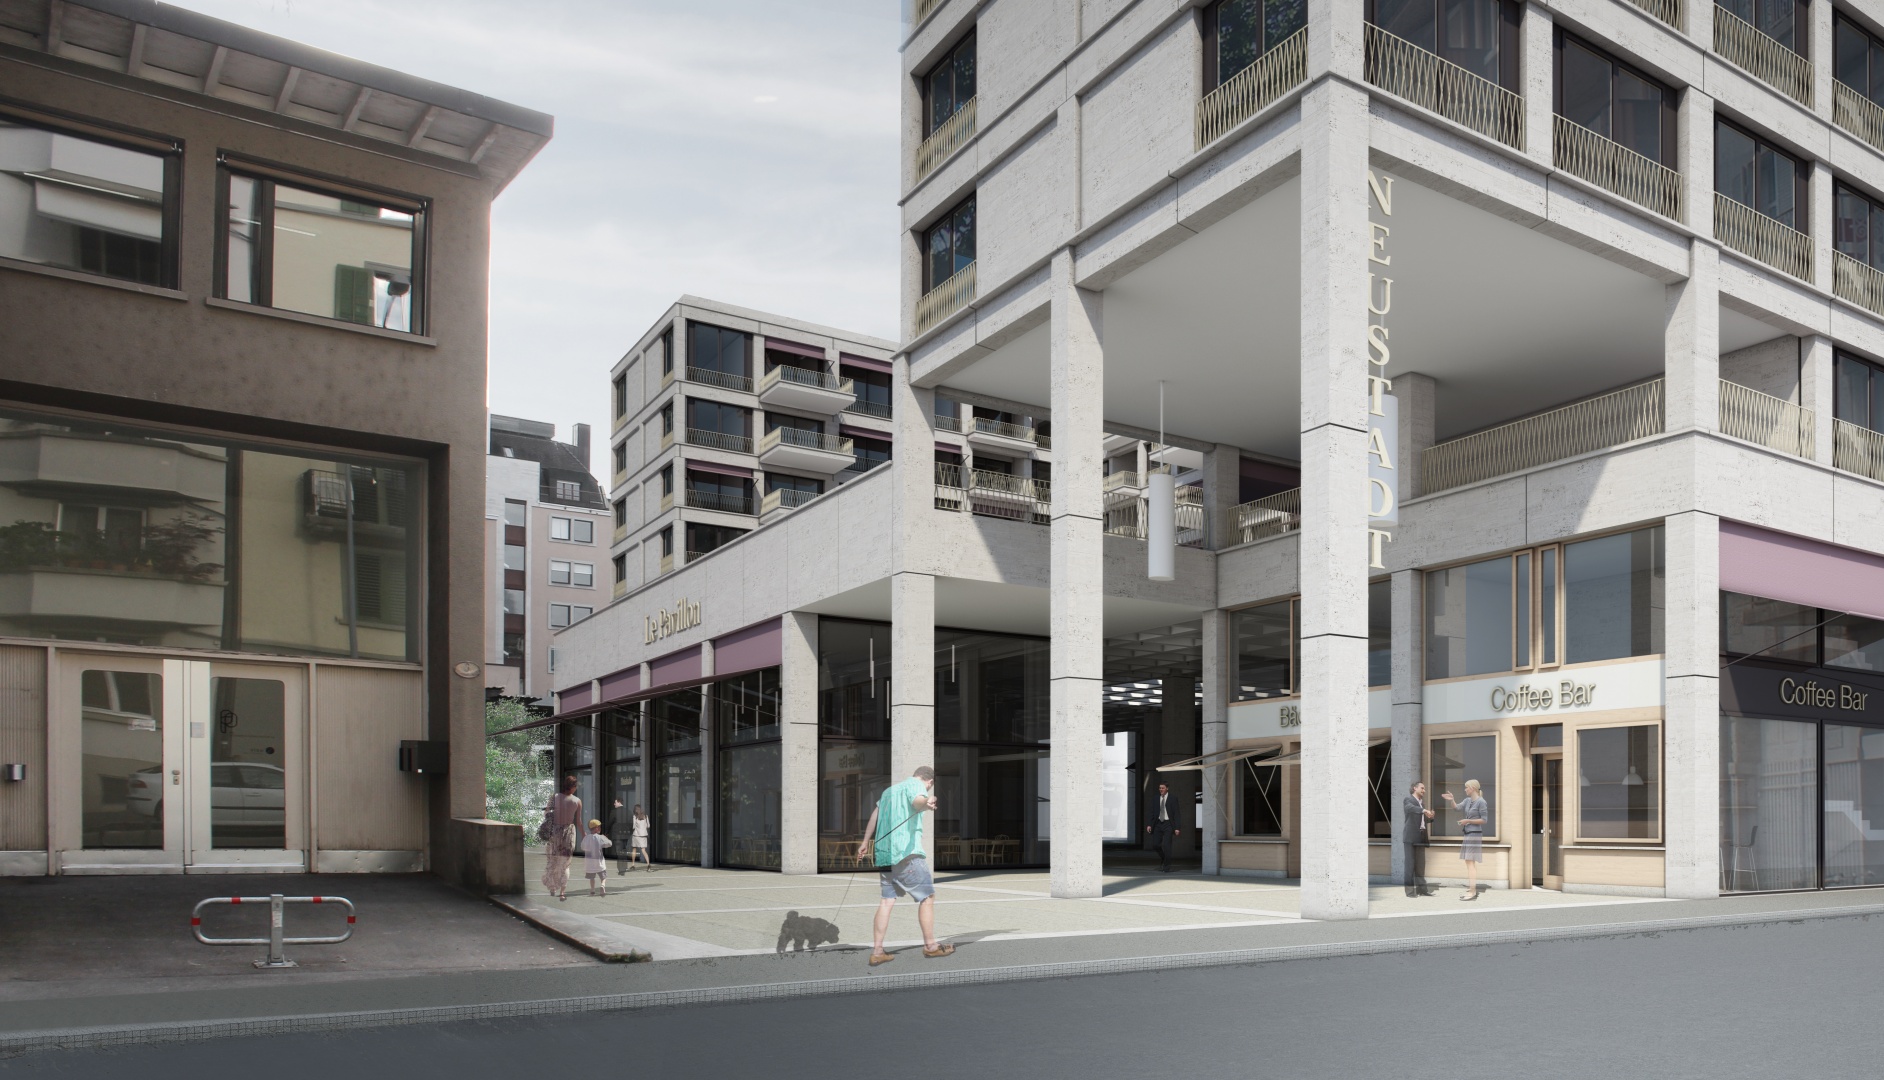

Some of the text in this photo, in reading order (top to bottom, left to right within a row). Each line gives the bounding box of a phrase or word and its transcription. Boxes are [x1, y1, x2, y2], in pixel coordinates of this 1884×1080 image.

[1368, 169, 1395, 570] NEUSTADT
[645, 597, 701, 645] Le Pavillon
[1491, 679, 1596, 712] Coffee Bar
[1780, 677, 1869, 711] Coffee Bar
[1280, 705, 1301, 728] Bä
